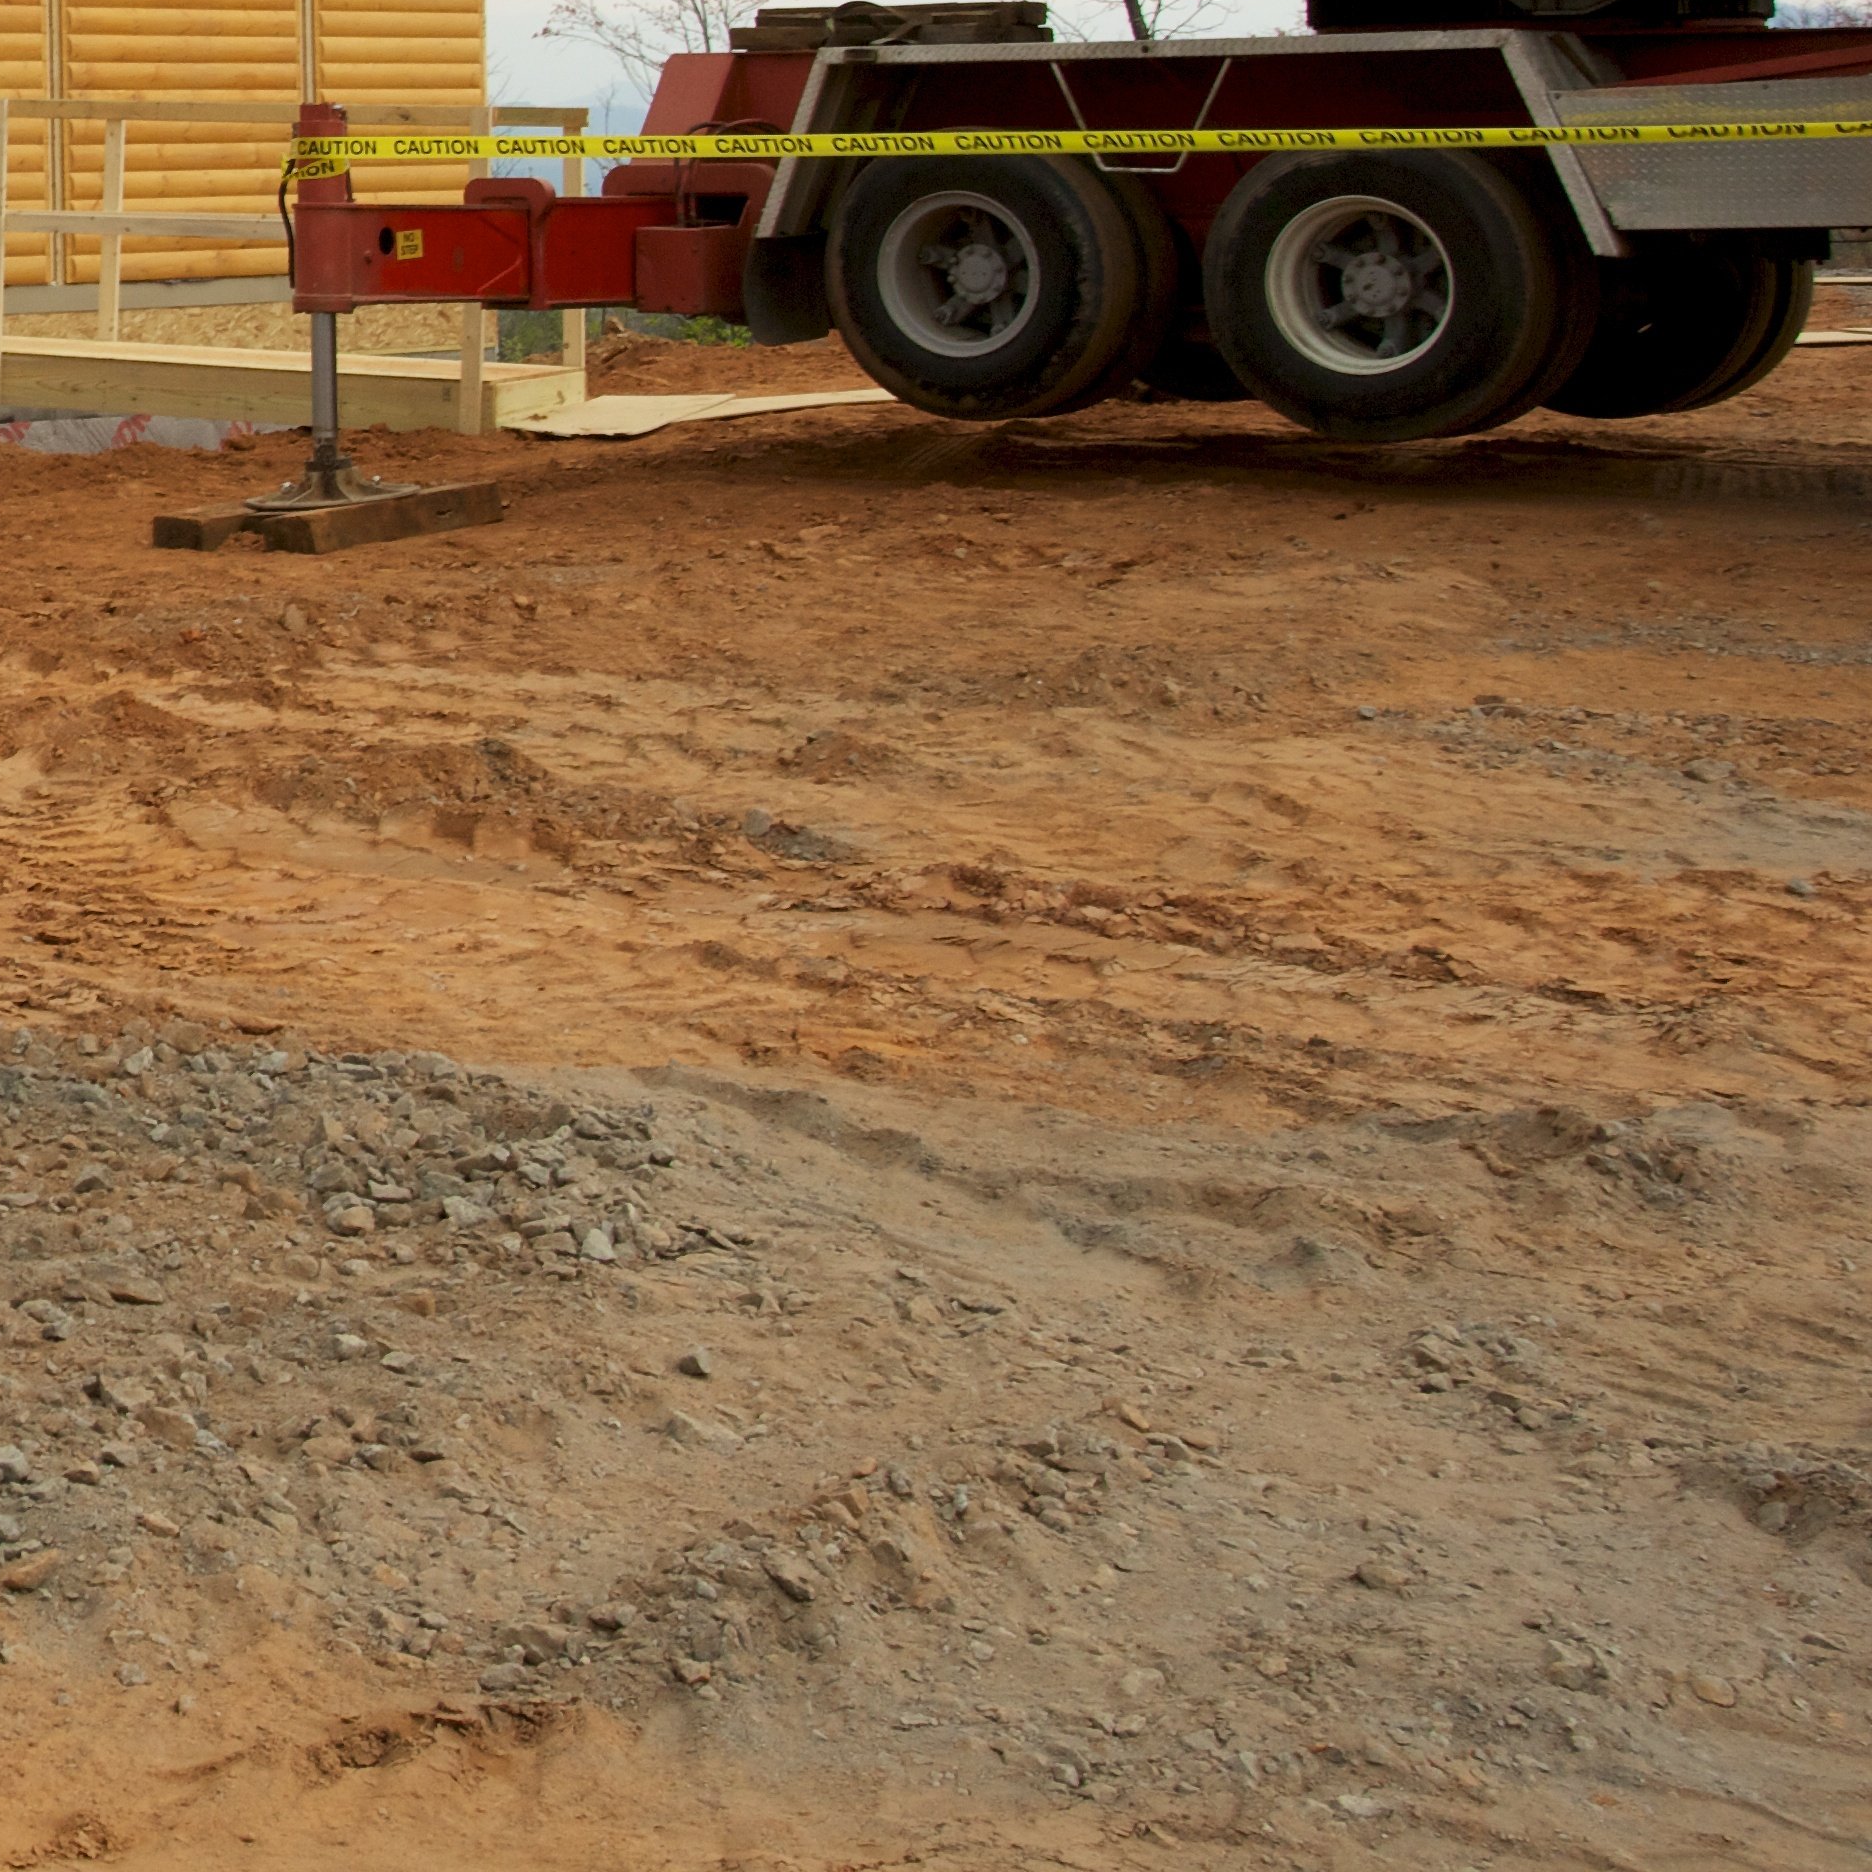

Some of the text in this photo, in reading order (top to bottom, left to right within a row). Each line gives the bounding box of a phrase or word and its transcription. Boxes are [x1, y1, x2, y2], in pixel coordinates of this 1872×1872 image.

[297, 139, 377, 155] CAUTION
[393, 139, 479, 155] CAUTION
[496, 139, 586, 155] CAUTION
[602, 139, 697, 155] CAUTION
[714, 137, 814, 154] CAUTION
[832, 136, 935, 152] CAUTION
[953, 133, 1063, 150] CAUTION
[1082, 132, 1196, 150] CAUTION
[1217, 131, 1337, 147] CAUTION
[1358, 129, 1484, 145] CAUTION
